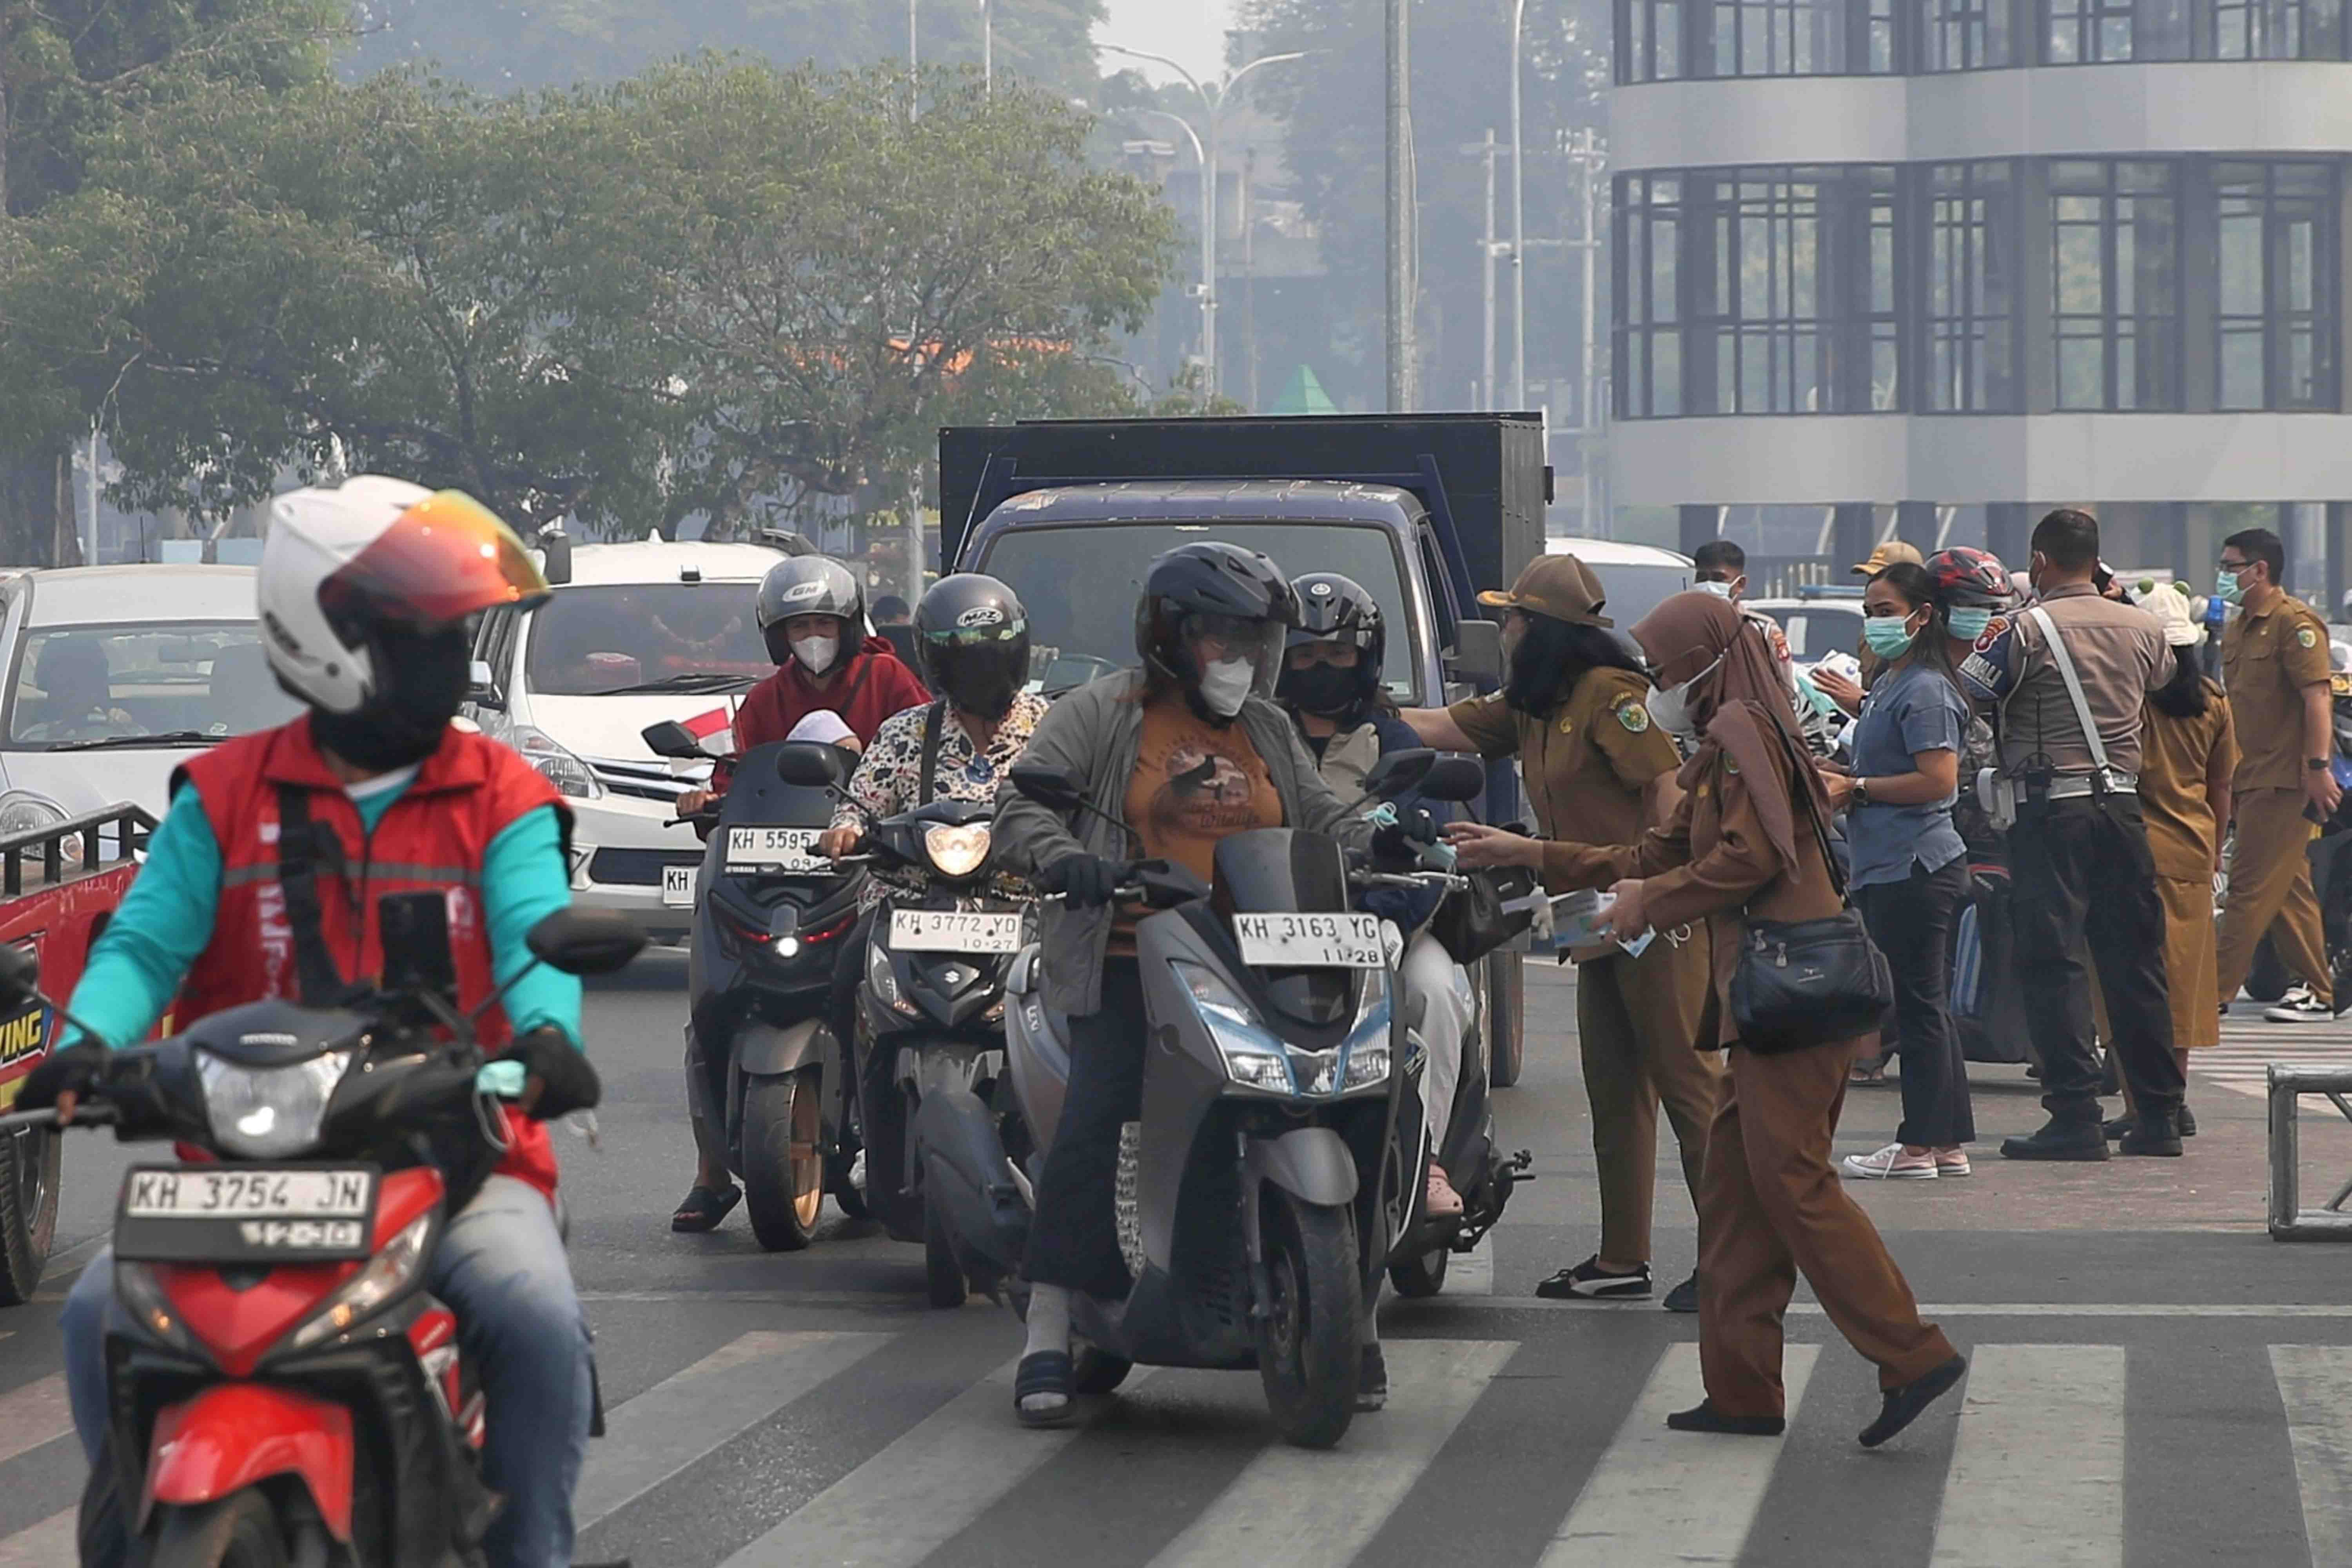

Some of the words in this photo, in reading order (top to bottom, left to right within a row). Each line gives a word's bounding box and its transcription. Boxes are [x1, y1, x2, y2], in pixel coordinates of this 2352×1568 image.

[792, 586, 818, 596] GM
[732, 831, 755, 849] KH
[765, 831, 810, 849] 5595
[667, 870, 688, 891] KH
[896, 913, 920, 929] KH
[931, 915, 981, 933] 3772
[993, 918, 1016, 933] YD
[1239, 917, 1269, 938] KH
[1282, 916, 1337, 937] 3163
[1349, 917, 1376, 939] YG
[136, 1176, 179, 1209] KH
[202, 1176, 290, 1210] 3754
[316, 1176, 361, 1208] JN
